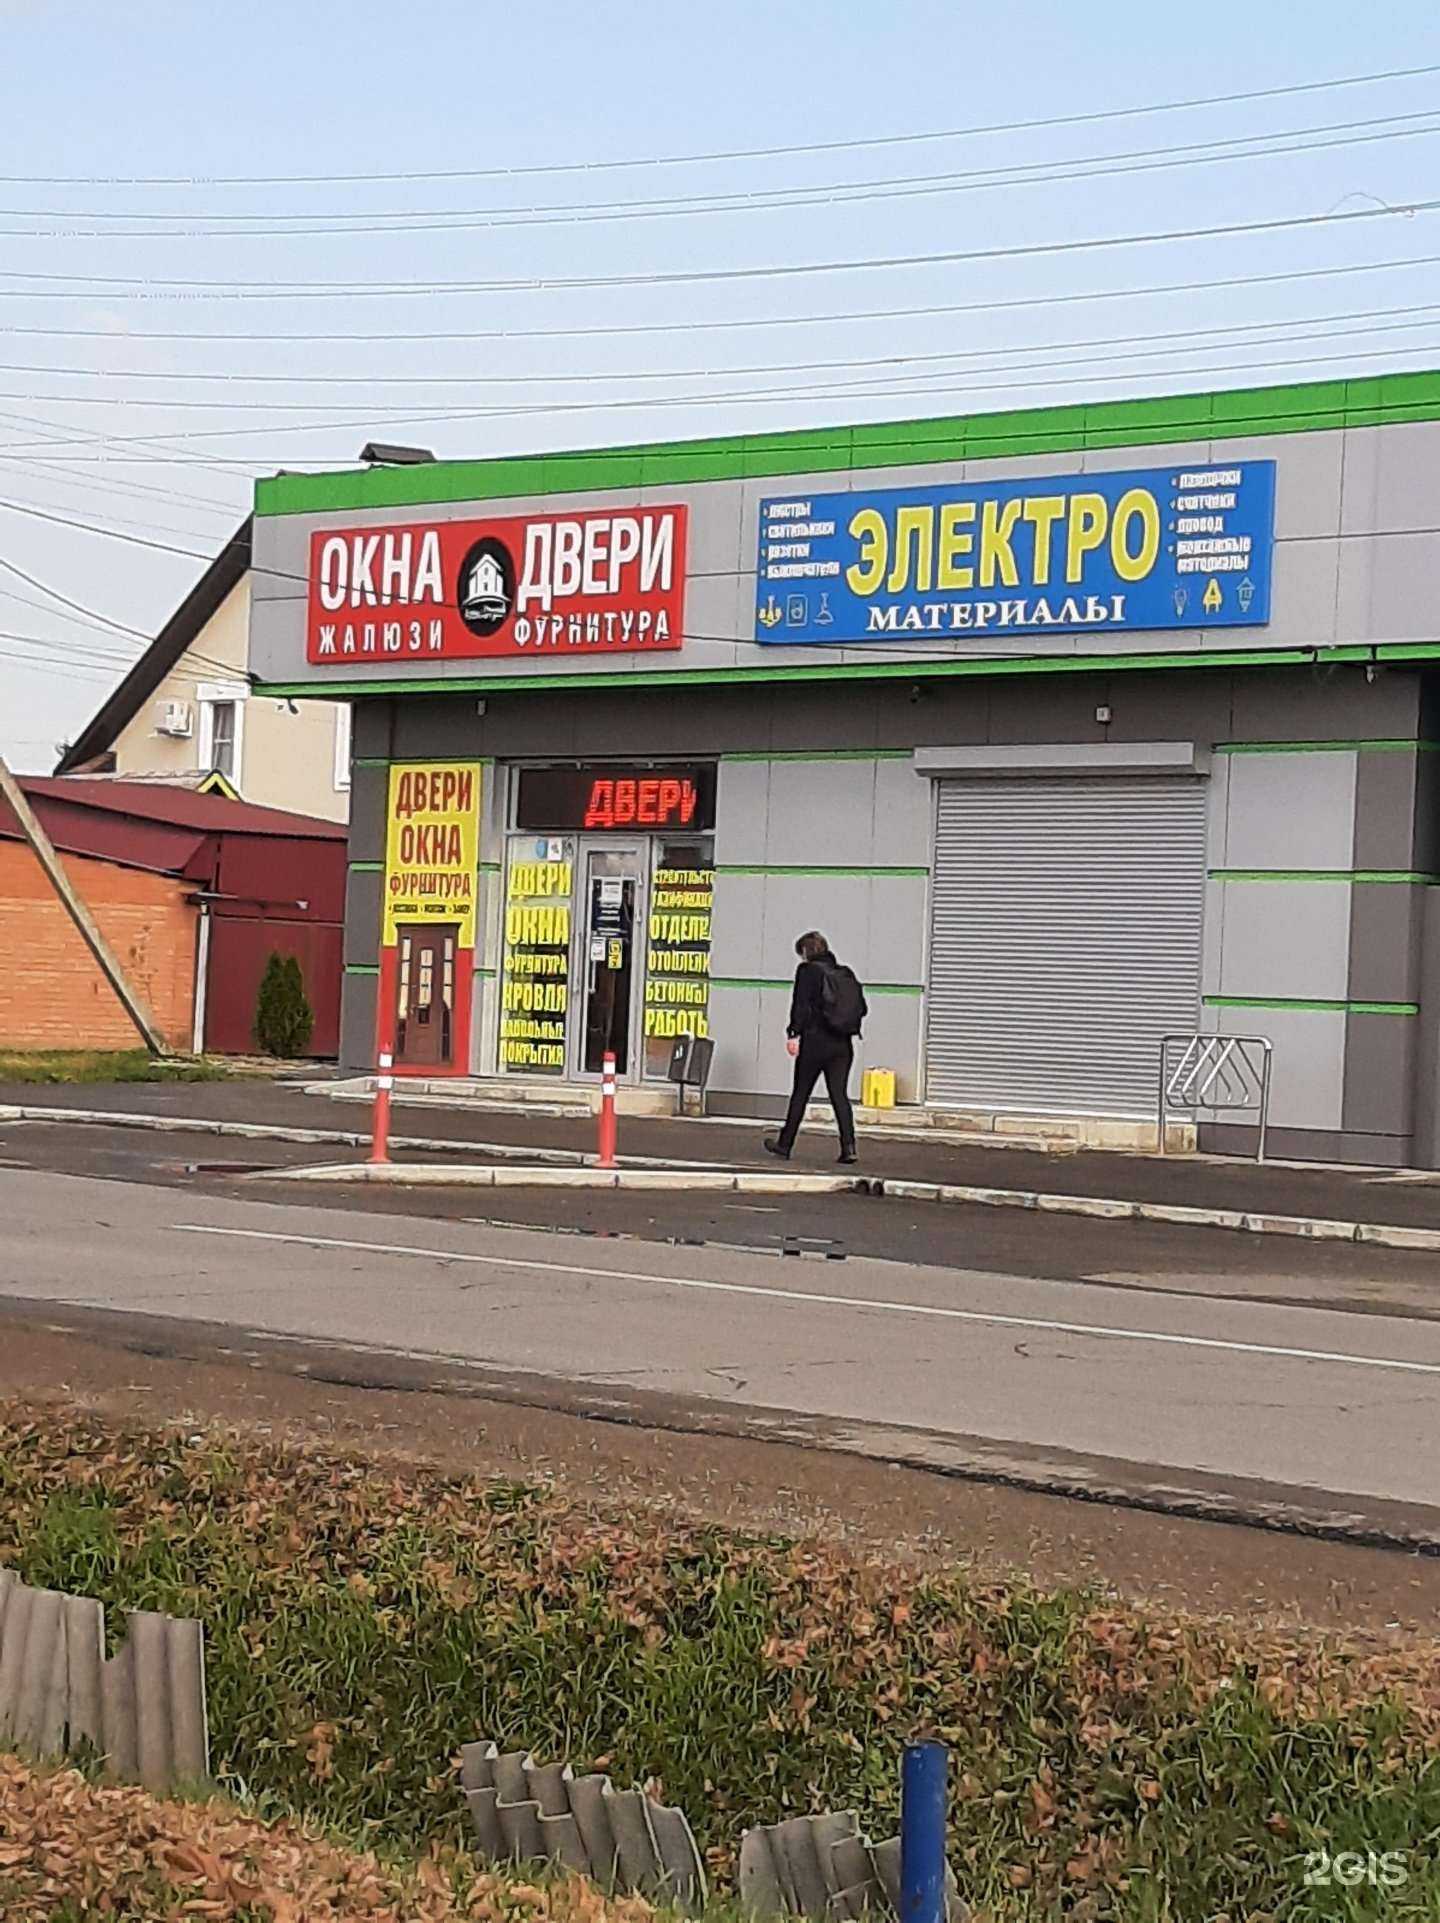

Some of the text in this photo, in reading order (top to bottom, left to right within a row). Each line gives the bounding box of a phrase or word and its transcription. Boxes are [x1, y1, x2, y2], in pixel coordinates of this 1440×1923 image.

[846, 489, 1160, 595] ЭЛЕКТРО
[320, 531, 444, 610] ОКНА
[517, 515, 674, 612] ДВЕРИ
[514, 609, 669, 647] ФУРНИТУРА
[866, 595, 1126, 632] МАТЕРИАЛЫ
[319, 619, 442, 654] ЖАЛЮЗИ
[396, 769, 472, 820] ДВЕРИ
[400, 824, 462, 866] ОКНА
[390, 871, 472, 897] ФУРНИТУРА
[508, 863, 572, 900] ДВЕРИ
[505, 905, 569, 945] ОКНА
[504, 953, 567, 977] ФУРНИТУРА
[502, 981, 567, 1013] КРОВЛЯ
